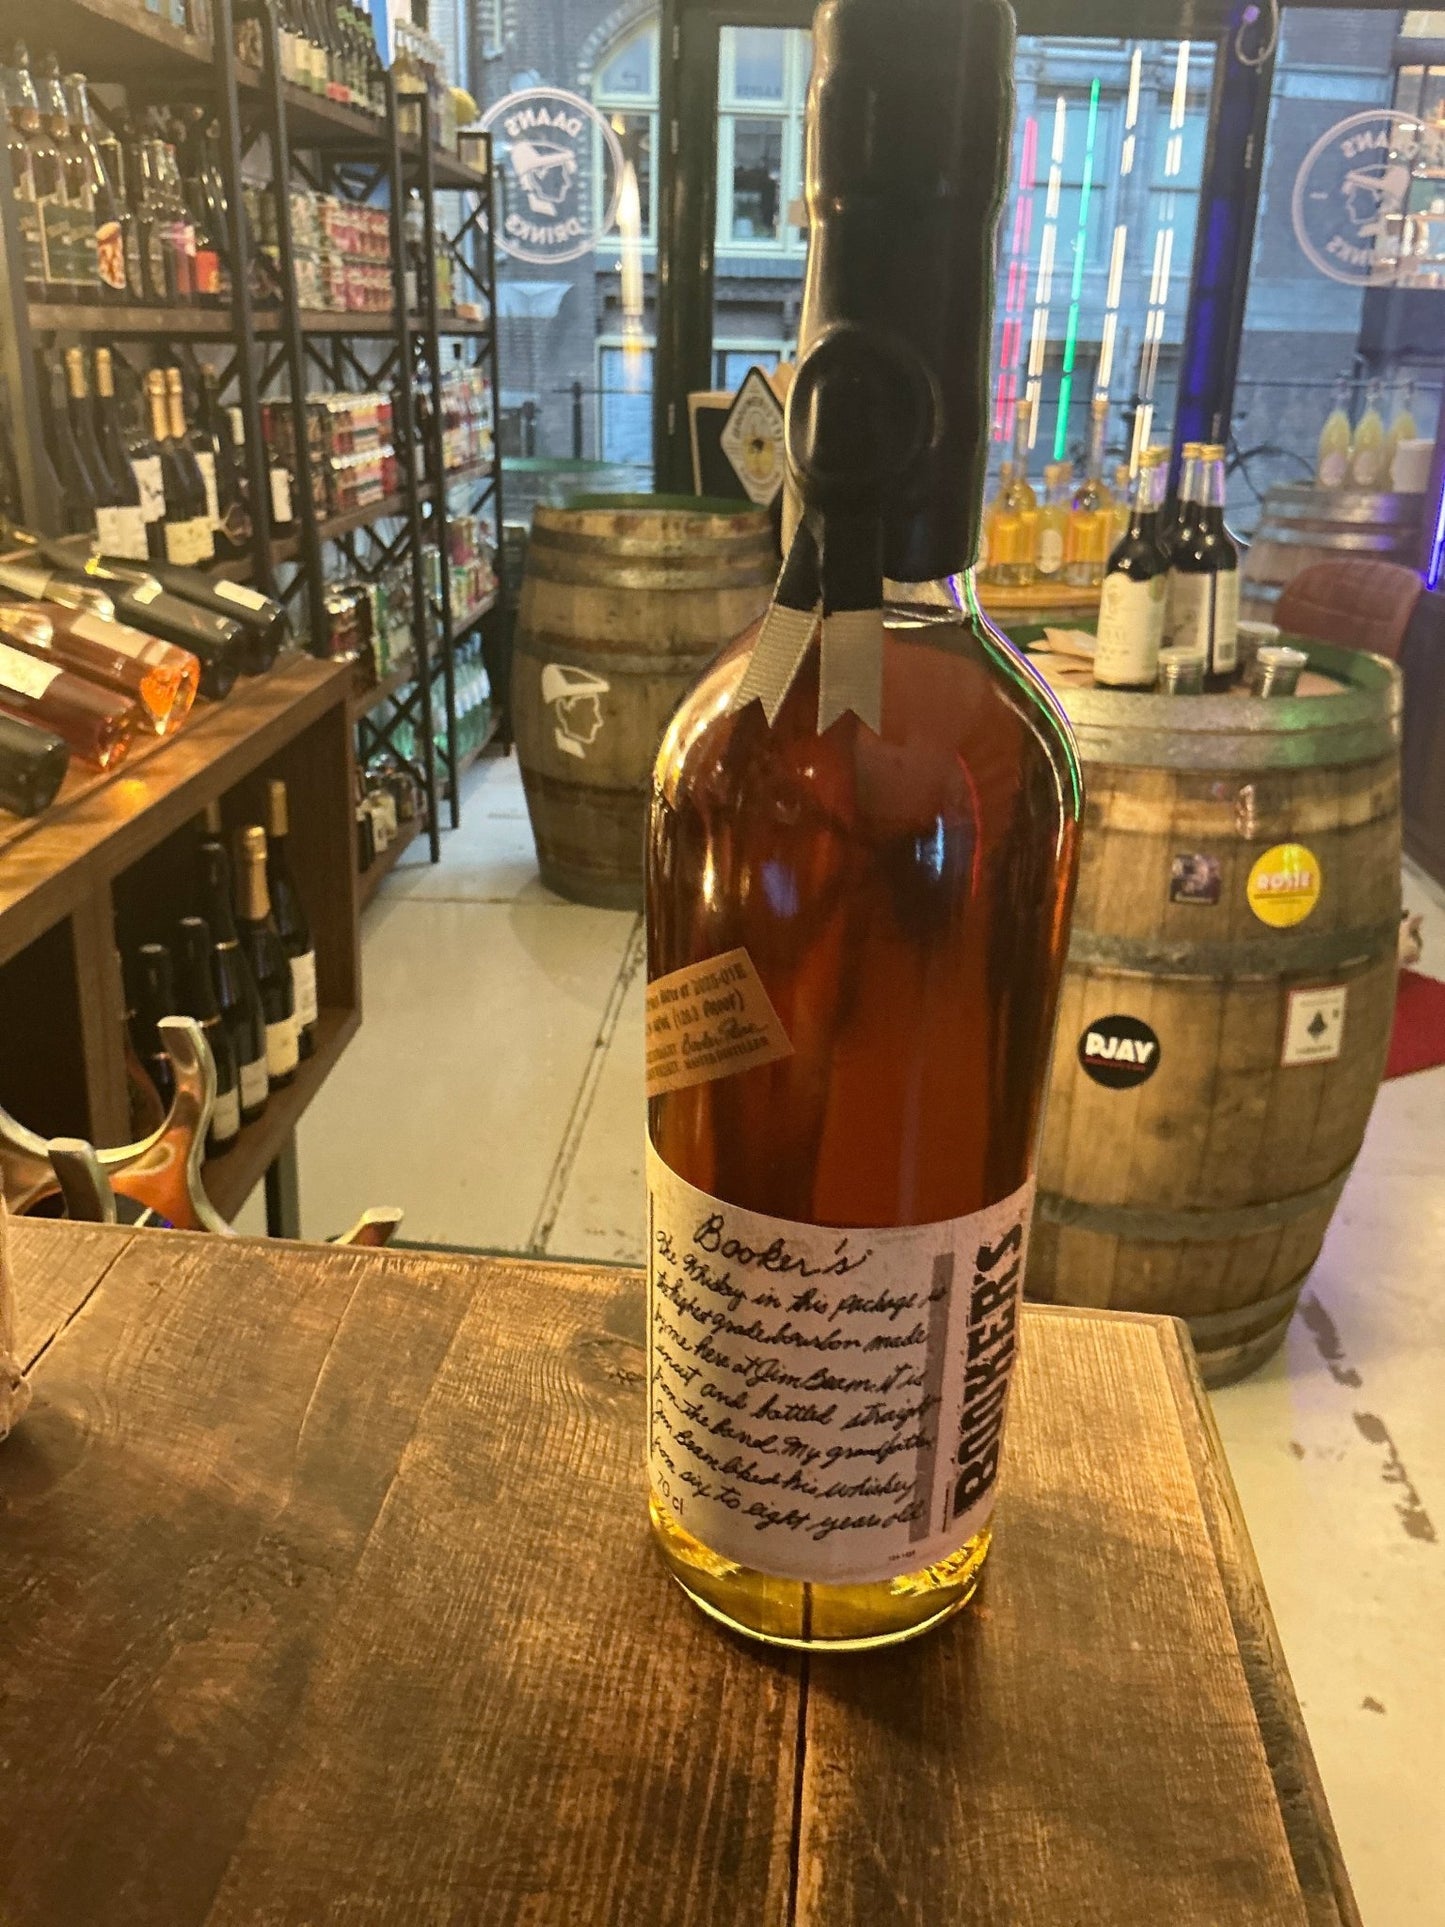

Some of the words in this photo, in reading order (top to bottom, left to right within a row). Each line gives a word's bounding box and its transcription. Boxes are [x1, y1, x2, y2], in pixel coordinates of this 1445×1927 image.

[1085, 1032, 1154, 1064] PJAY
[752, 1287, 781, 1309] in
[786, 1287, 828, 1314] this
[827, 1289, 918, 1322] package
[759, 1322, 861, 1350] bourbon
[862, 1322, 928, 1353] made
[693, 1334, 730, 1368] here
[745, 1358, 801, 1388] Jim
[953, 1222, 1022, 1519] BOOKER'S
[679, 1399, 709, 1427] the
[701, 1383, 748, 1410] and
[750, 1393, 838, 1425] bottled
[658, 1470, 671, 1498] 70
[673, 1430, 719, 1472] Beam
[814, 1472, 918, 1505] whiskey
[713, 1485, 742, 1510] to
